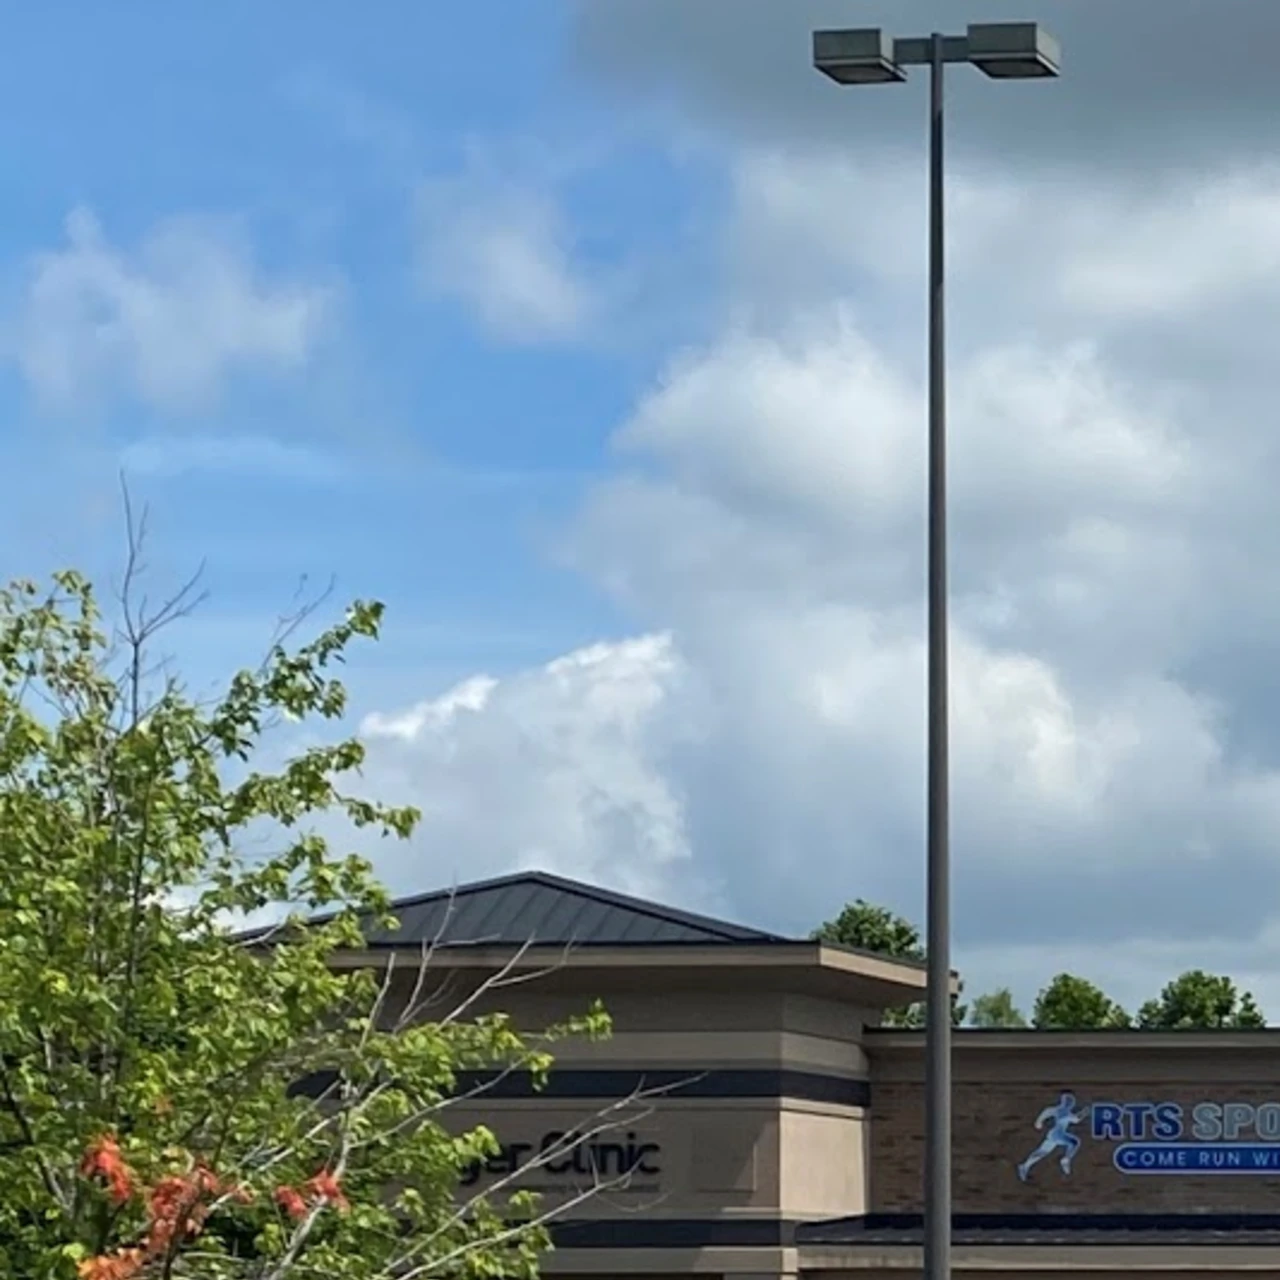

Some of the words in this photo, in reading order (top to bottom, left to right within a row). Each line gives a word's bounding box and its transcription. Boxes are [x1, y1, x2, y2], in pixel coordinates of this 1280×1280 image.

[1092, 1103, 1184, 1140] RTS
[541, 1131, 661, 1174] Clinic
[1122, 1151, 1187, 1167] COME
[1198, 1151, 1241, 1167] RUN
